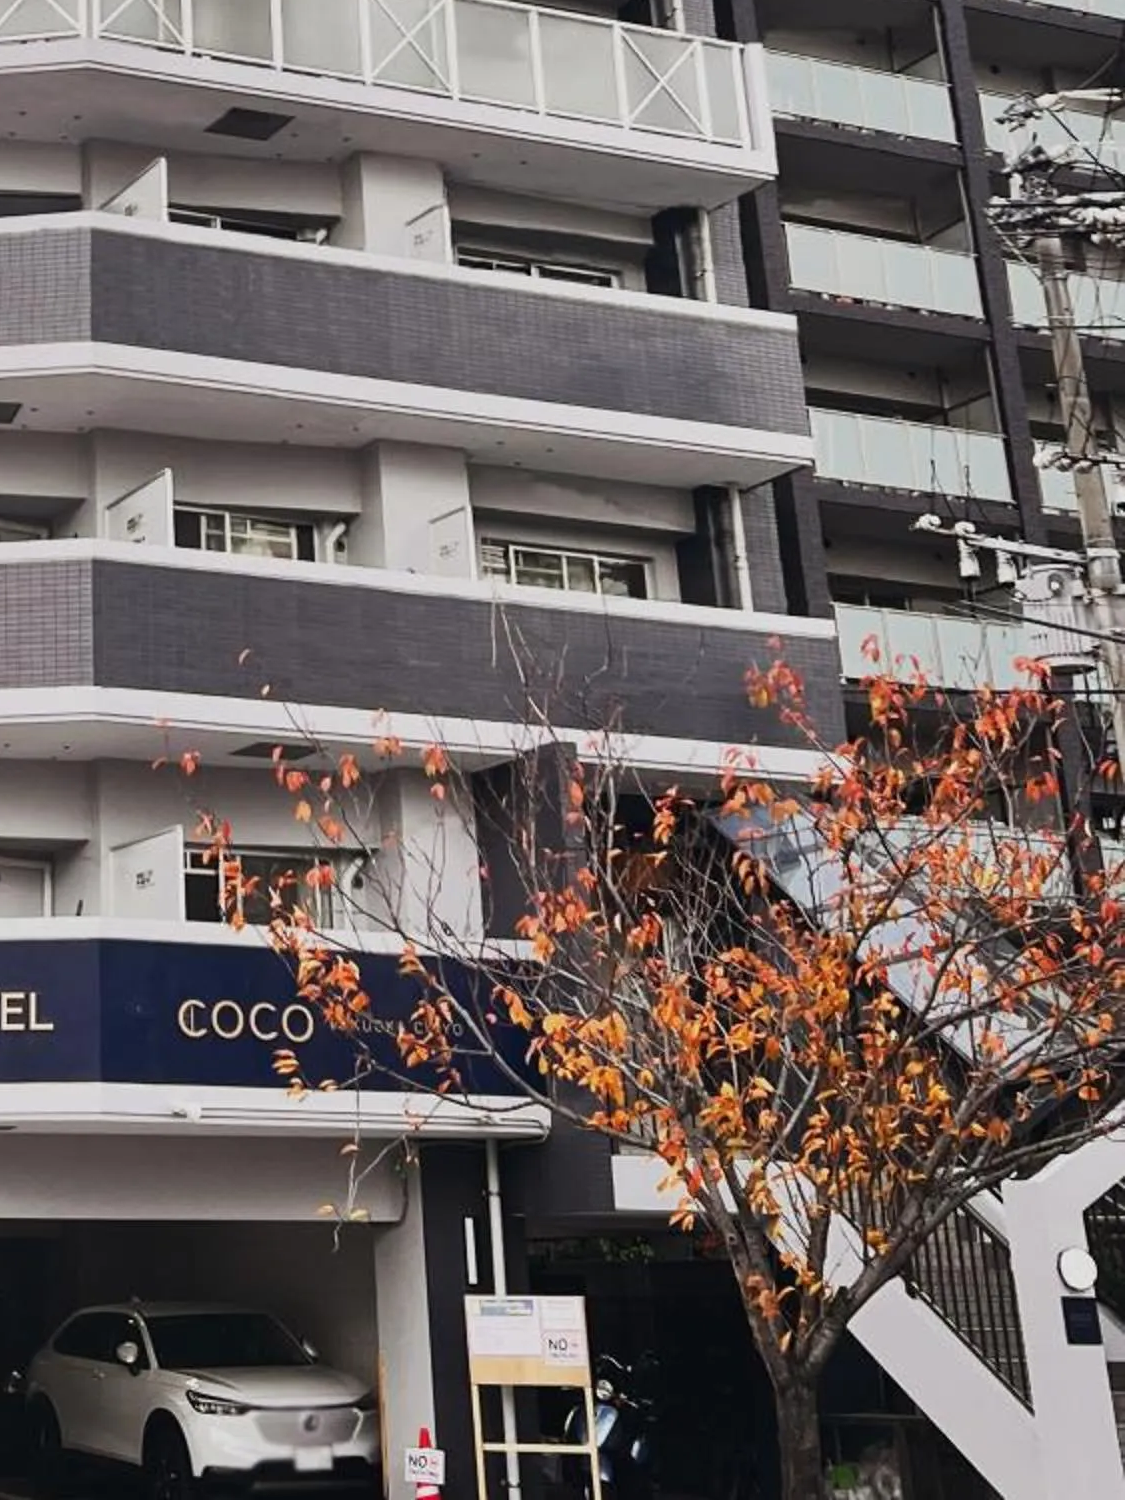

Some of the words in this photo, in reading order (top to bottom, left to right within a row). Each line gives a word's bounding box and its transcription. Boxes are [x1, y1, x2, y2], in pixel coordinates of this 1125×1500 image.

[178, 999, 315, 1043] COCO
[548, 1339, 568, 1351] NO
[408, 1454, 428, 1469] NO
